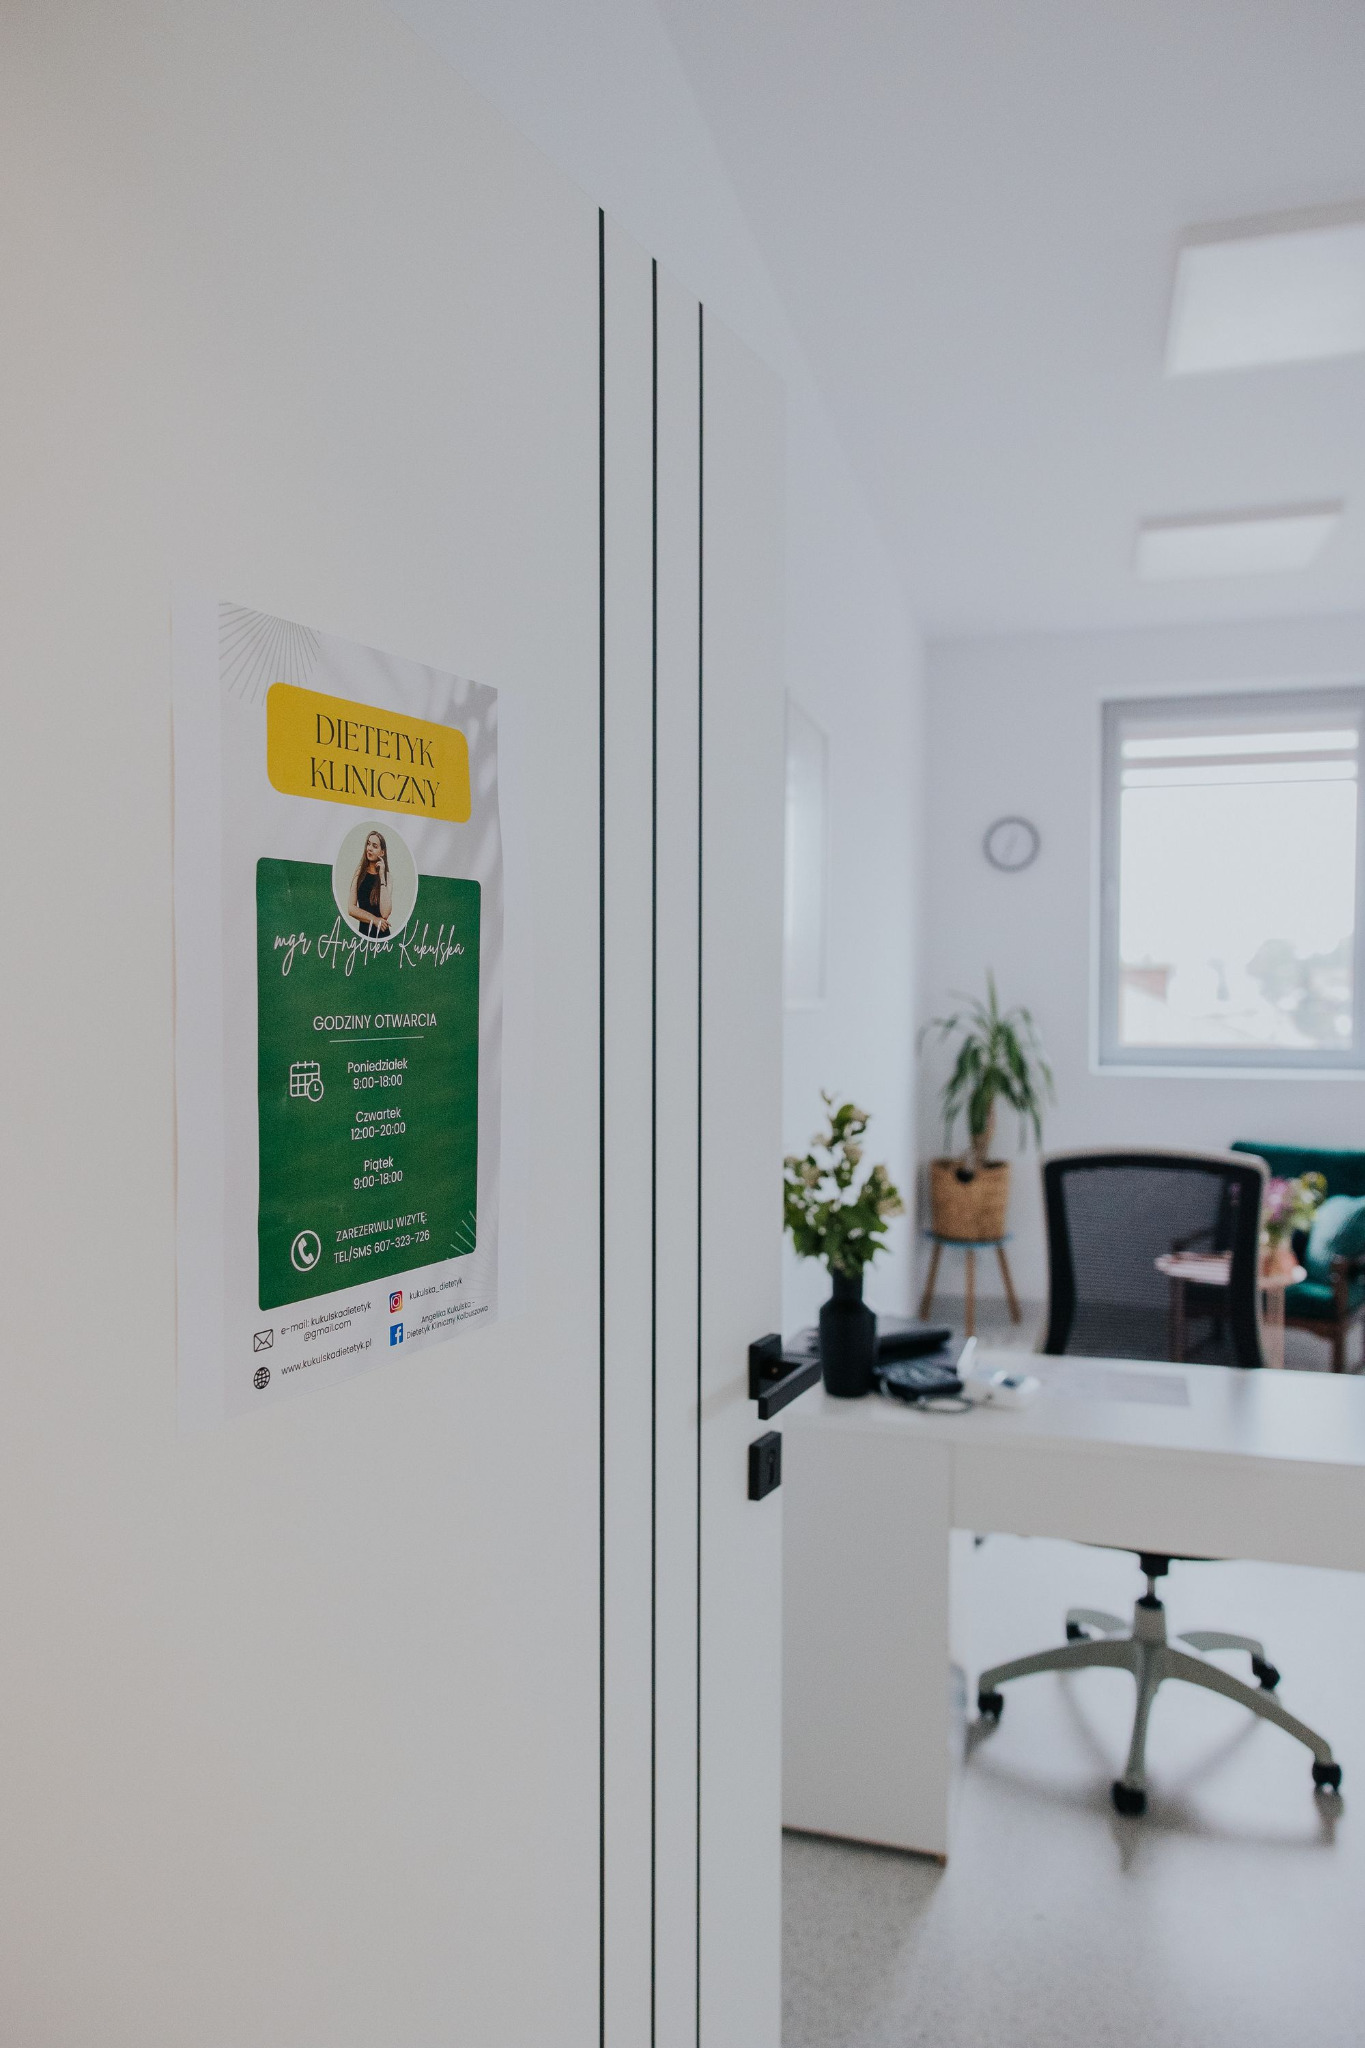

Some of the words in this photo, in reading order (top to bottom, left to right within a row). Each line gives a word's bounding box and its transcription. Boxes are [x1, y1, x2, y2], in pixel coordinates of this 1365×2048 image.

[316, 713, 435, 769] DIETETYK
[310, 756, 440, 808] KLINICZNY
[274, 932, 311, 976] mgr
[317, 916, 394, 977] Angelika
[399, 919, 465, 969] Kukulska
[313, 1014, 371, 1031] GODZINY
[374, 1013, 437, 1029] OTWARCIA
[347, 1058, 408, 1074] Poniedziałek
[353, 1074, 403, 1090] 9:00-18:00
[355, 1107, 402, 1123] Czwartek
[350, 1122, 406, 1140] 12:00-20:00
[364, 1156, 394, 1173] Piątek
[353, 1170, 403, 1190] 9:00-18:00
[336, 1218, 394, 1242] ZAREZERWUJ
[396, 1211, 428, 1228] WIZYTĘ:
[333, 1245, 372, 1264] TEL/SMS
[374, 1230, 430, 1254] 607-323-726
[409, 1277, 463, 1300] kukulska_dietetyk
[280, 1318, 310, 1335] e-mail:
[310, 1301, 372, 1327] kukulskadietetyk
[421, 1308, 447, 1324] Angelika
[447, 1300, 472, 1315] Kukulska
[303, 1319, 352, 1342] @gmail.com
[406, 1324, 431, 1340] Dietetyk
[431, 1316, 456, 1332] Kliniczny
[281, 1338, 372, 1376] www.kukulskadietetyk.pl
